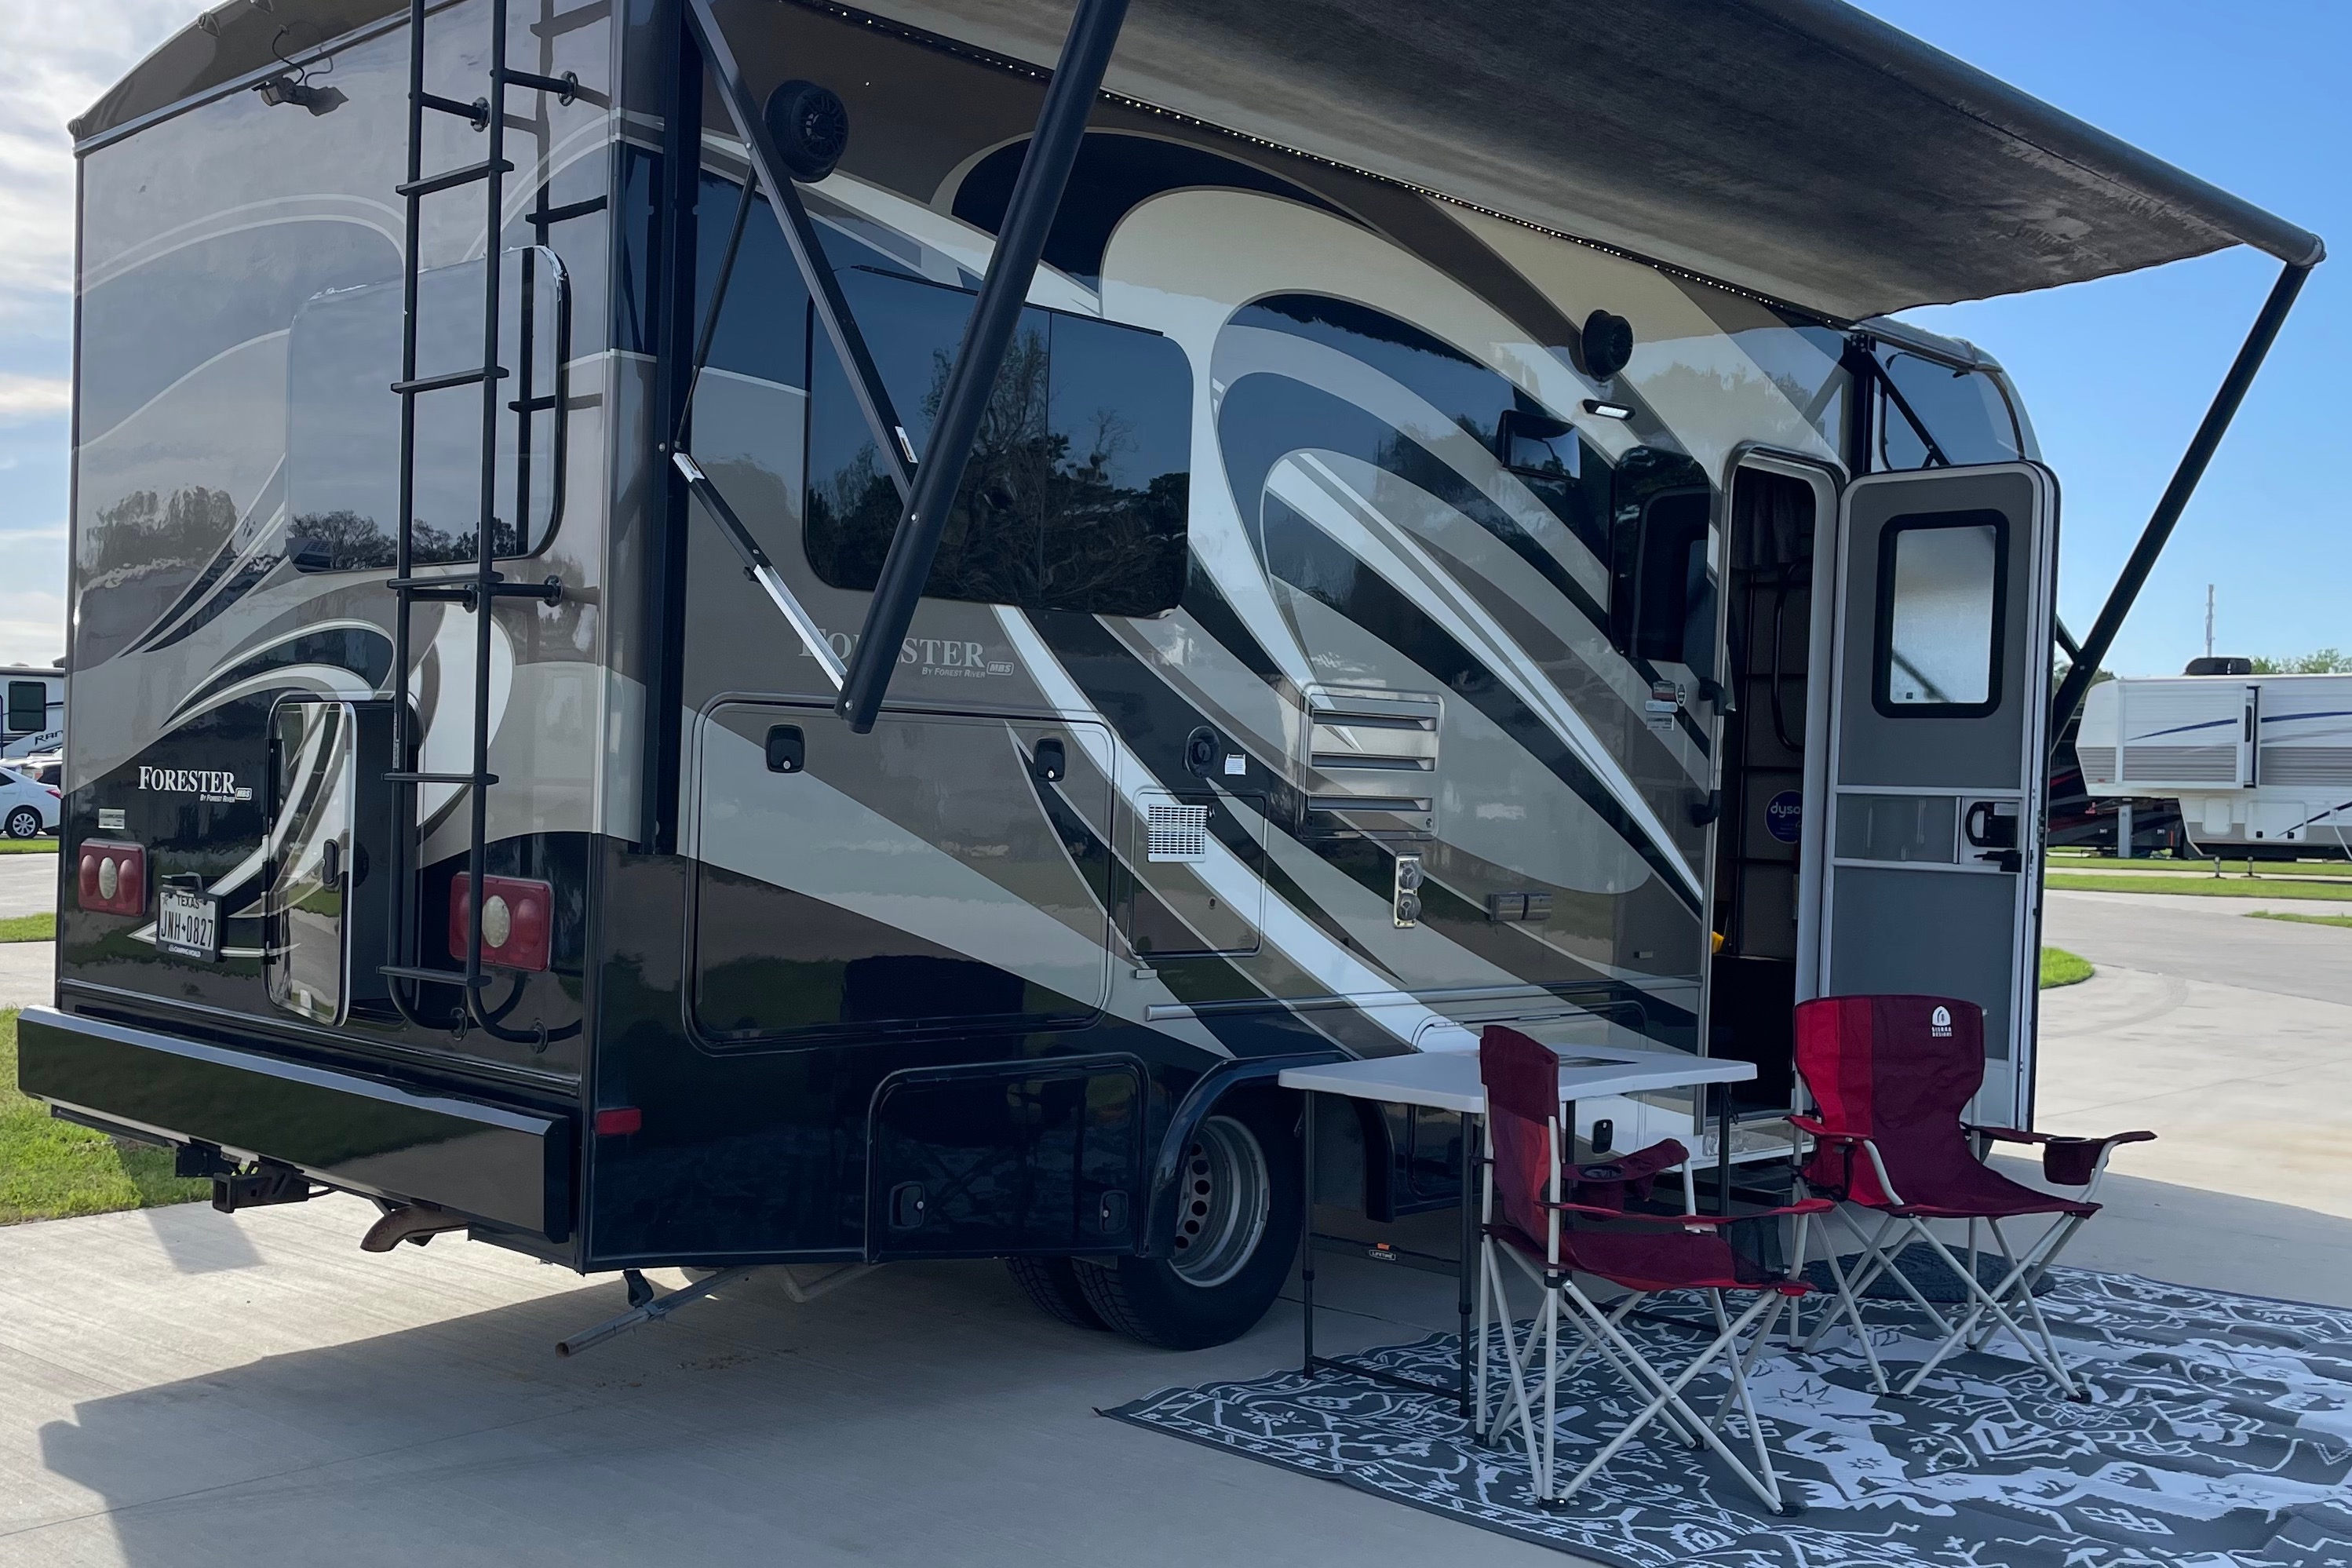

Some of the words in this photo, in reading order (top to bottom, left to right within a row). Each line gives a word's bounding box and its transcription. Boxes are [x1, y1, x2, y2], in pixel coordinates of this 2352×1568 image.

[798, 628, 985, 667] OSTER
[934, 667, 961, 676] FOREST
[964, 669, 986, 678] RIVER
[990, 664, 1011, 673] MBS
[138, 766, 235, 793] FORESTER
[1770, 801, 1801, 819] dyso
[177, 895, 199, 909] TEXAS
